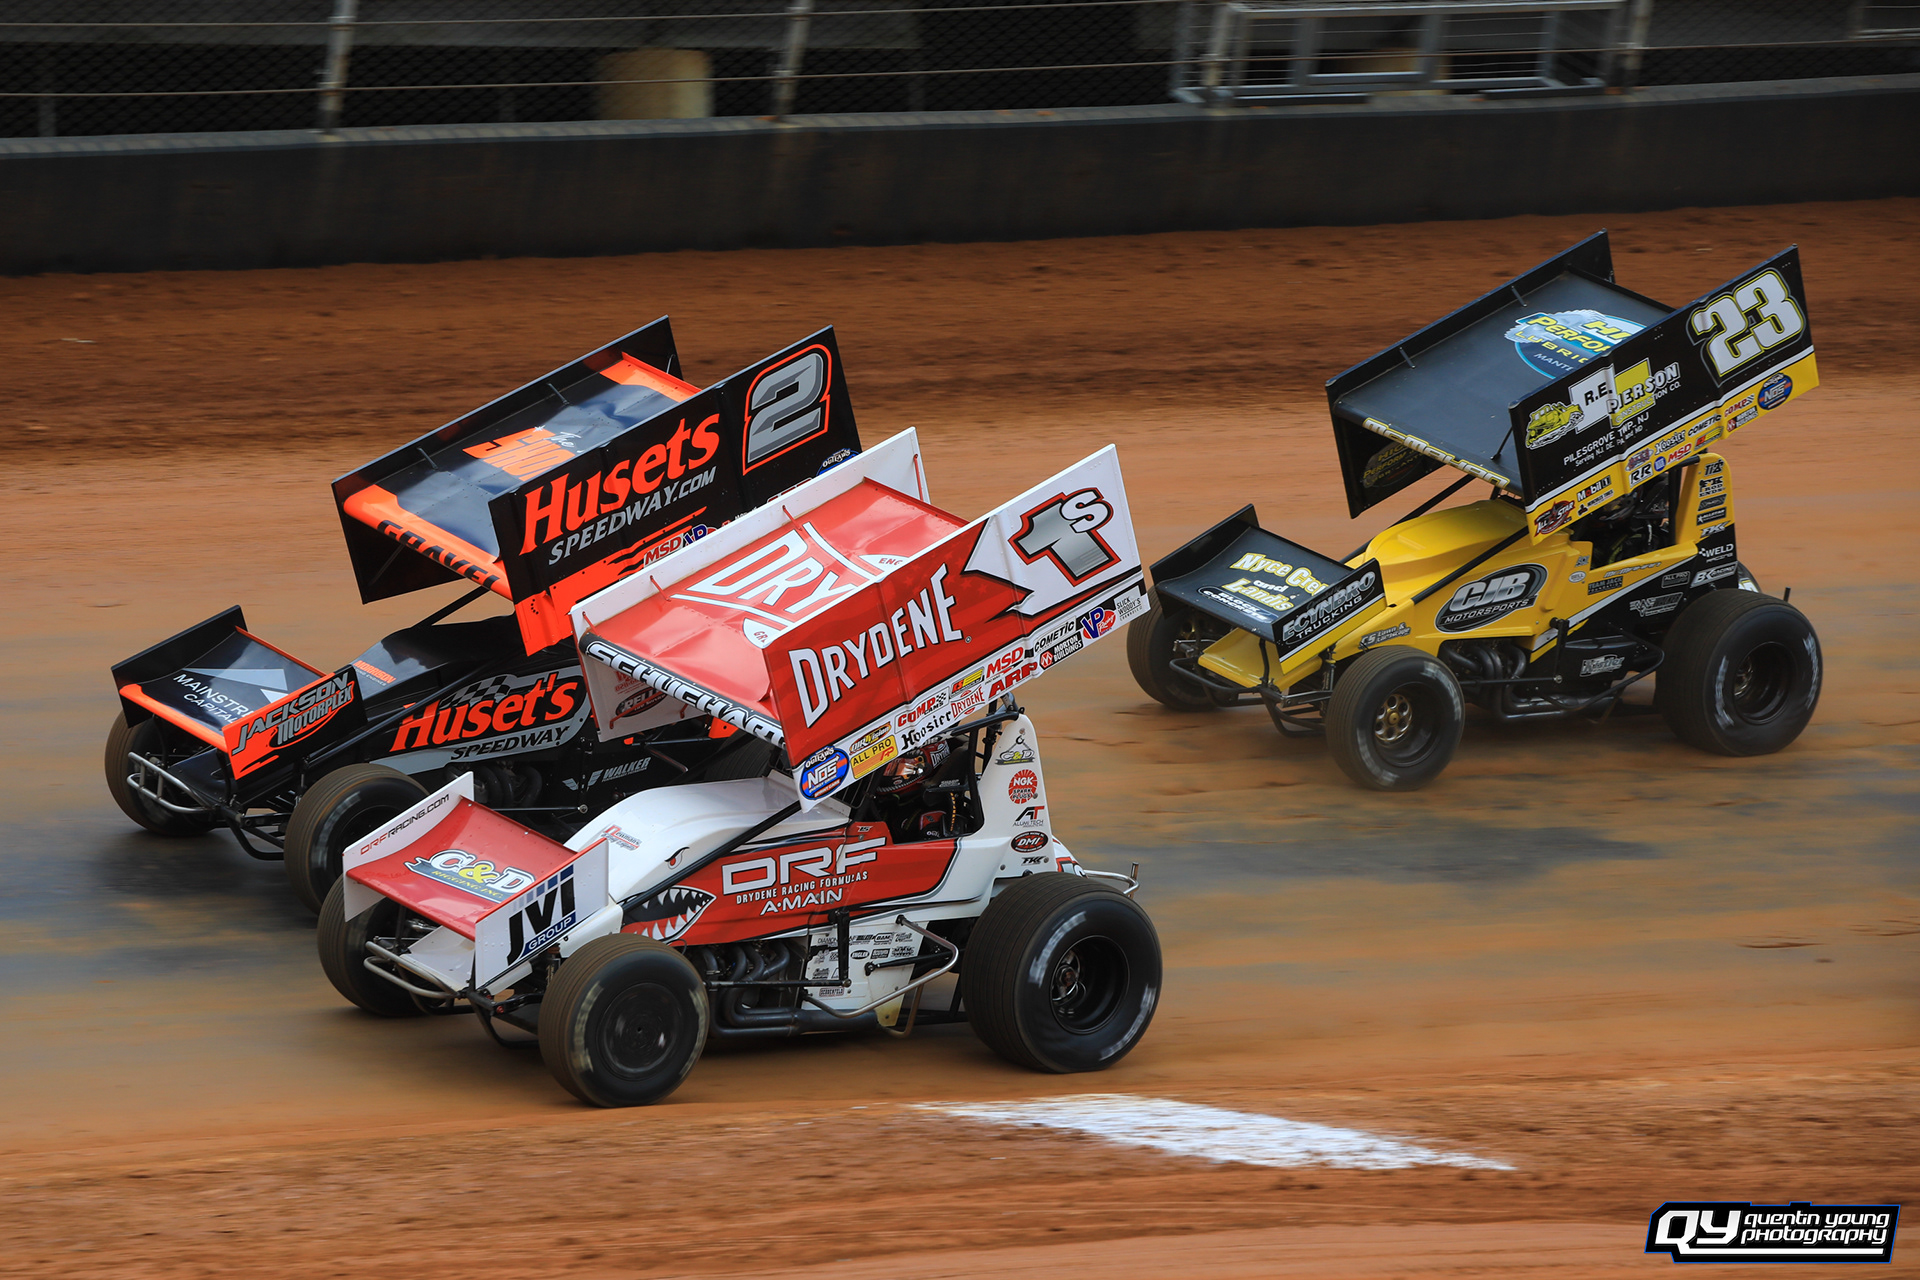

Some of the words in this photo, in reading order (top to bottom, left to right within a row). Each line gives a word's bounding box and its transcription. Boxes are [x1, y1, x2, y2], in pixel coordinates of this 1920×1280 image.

[1691, 271, 1804, 377] 23
[1584, 382, 1613, 406] R.E.
[1607, 363, 1679, 414] PIERSON
[746, 351, 826, 465] 2
[1563, 431, 1615, 465] PILESGROVE
[1637, 412, 1649, 424] NJ
[1688, 414, 1722, 438] COMETIC
[1655, 432, 1685, 455] Hoosier
[1668, 443, 1692, 462] MSD
[519, 413, 720, 556] Husets
[1630, 463, 1652, 485] RR
[1577, 480, 1601, 502] Mobil
[549, 466, 717, 565] SPEEDWAY.COM
[645, 536, 682, 565] MSD
[1230, 553, 1293, 577] Nyce
[1706, 543, 1734, 558] WELD
[1222, 578, 1294, 612] Landis
[1254, 579, 1289, 593] and
[1450, 572, 1531, 612] CJB
[1117, 596, 1131, 609] SLICK
[1296, 595, 1362, 639] TRUCKING
[1445, 598, 1530, 623] MOTORSPORTS
[1034, 620, 1075, 652] COMETIC
[1082, 607, 1104, 639] VP
[788, 562, 964, 728] DRYDENE
[1054, 635, 1079, 654] MORTON
[1054, 640, 1082, 662] BUILDINGS
[986, 646, 1024, 678] MSD
[989, 661, 1038, 698] ARP
[183, 692, 240, 724] CAPITAL
[232, 671, 349, 757] JACKSON
[277, 684, 353, 746] MOTORPLEX
[389, 672, 579, 752] Huset's
[897, 697, 936, 728] COMP
[951, 686, 985, 718] DRYDENE
[450, 726, 570, 761] SPEEDWAY
[901, 711, 951, 750] Hoosier
[603, 757, 652, 779] WALKER
[853, 752, 870, 766] ALL
[872, 739, 892, 754] PRO
[1000, 750, 1035, 761] C&D
[807, 755, 840, 790] NOS
[1013, 776, 1034, 786] NGK
[360, 794, 450, 855] DRFRACING.COM
[1017, 837, 1041, 846] DMI
[430, 851, 534, 893] C&D
[431, 871, 481, 890] RIGGING
[722, 837, 887, 896] DRF
[736, 887, 779, 904] DRYDENE
[781, 882, 816, 894] RACING
[819, 871, 868, 889] FORMULAS
[507, 877, 576, 966] JVI
[528, 916, 572, 950] GROUP
